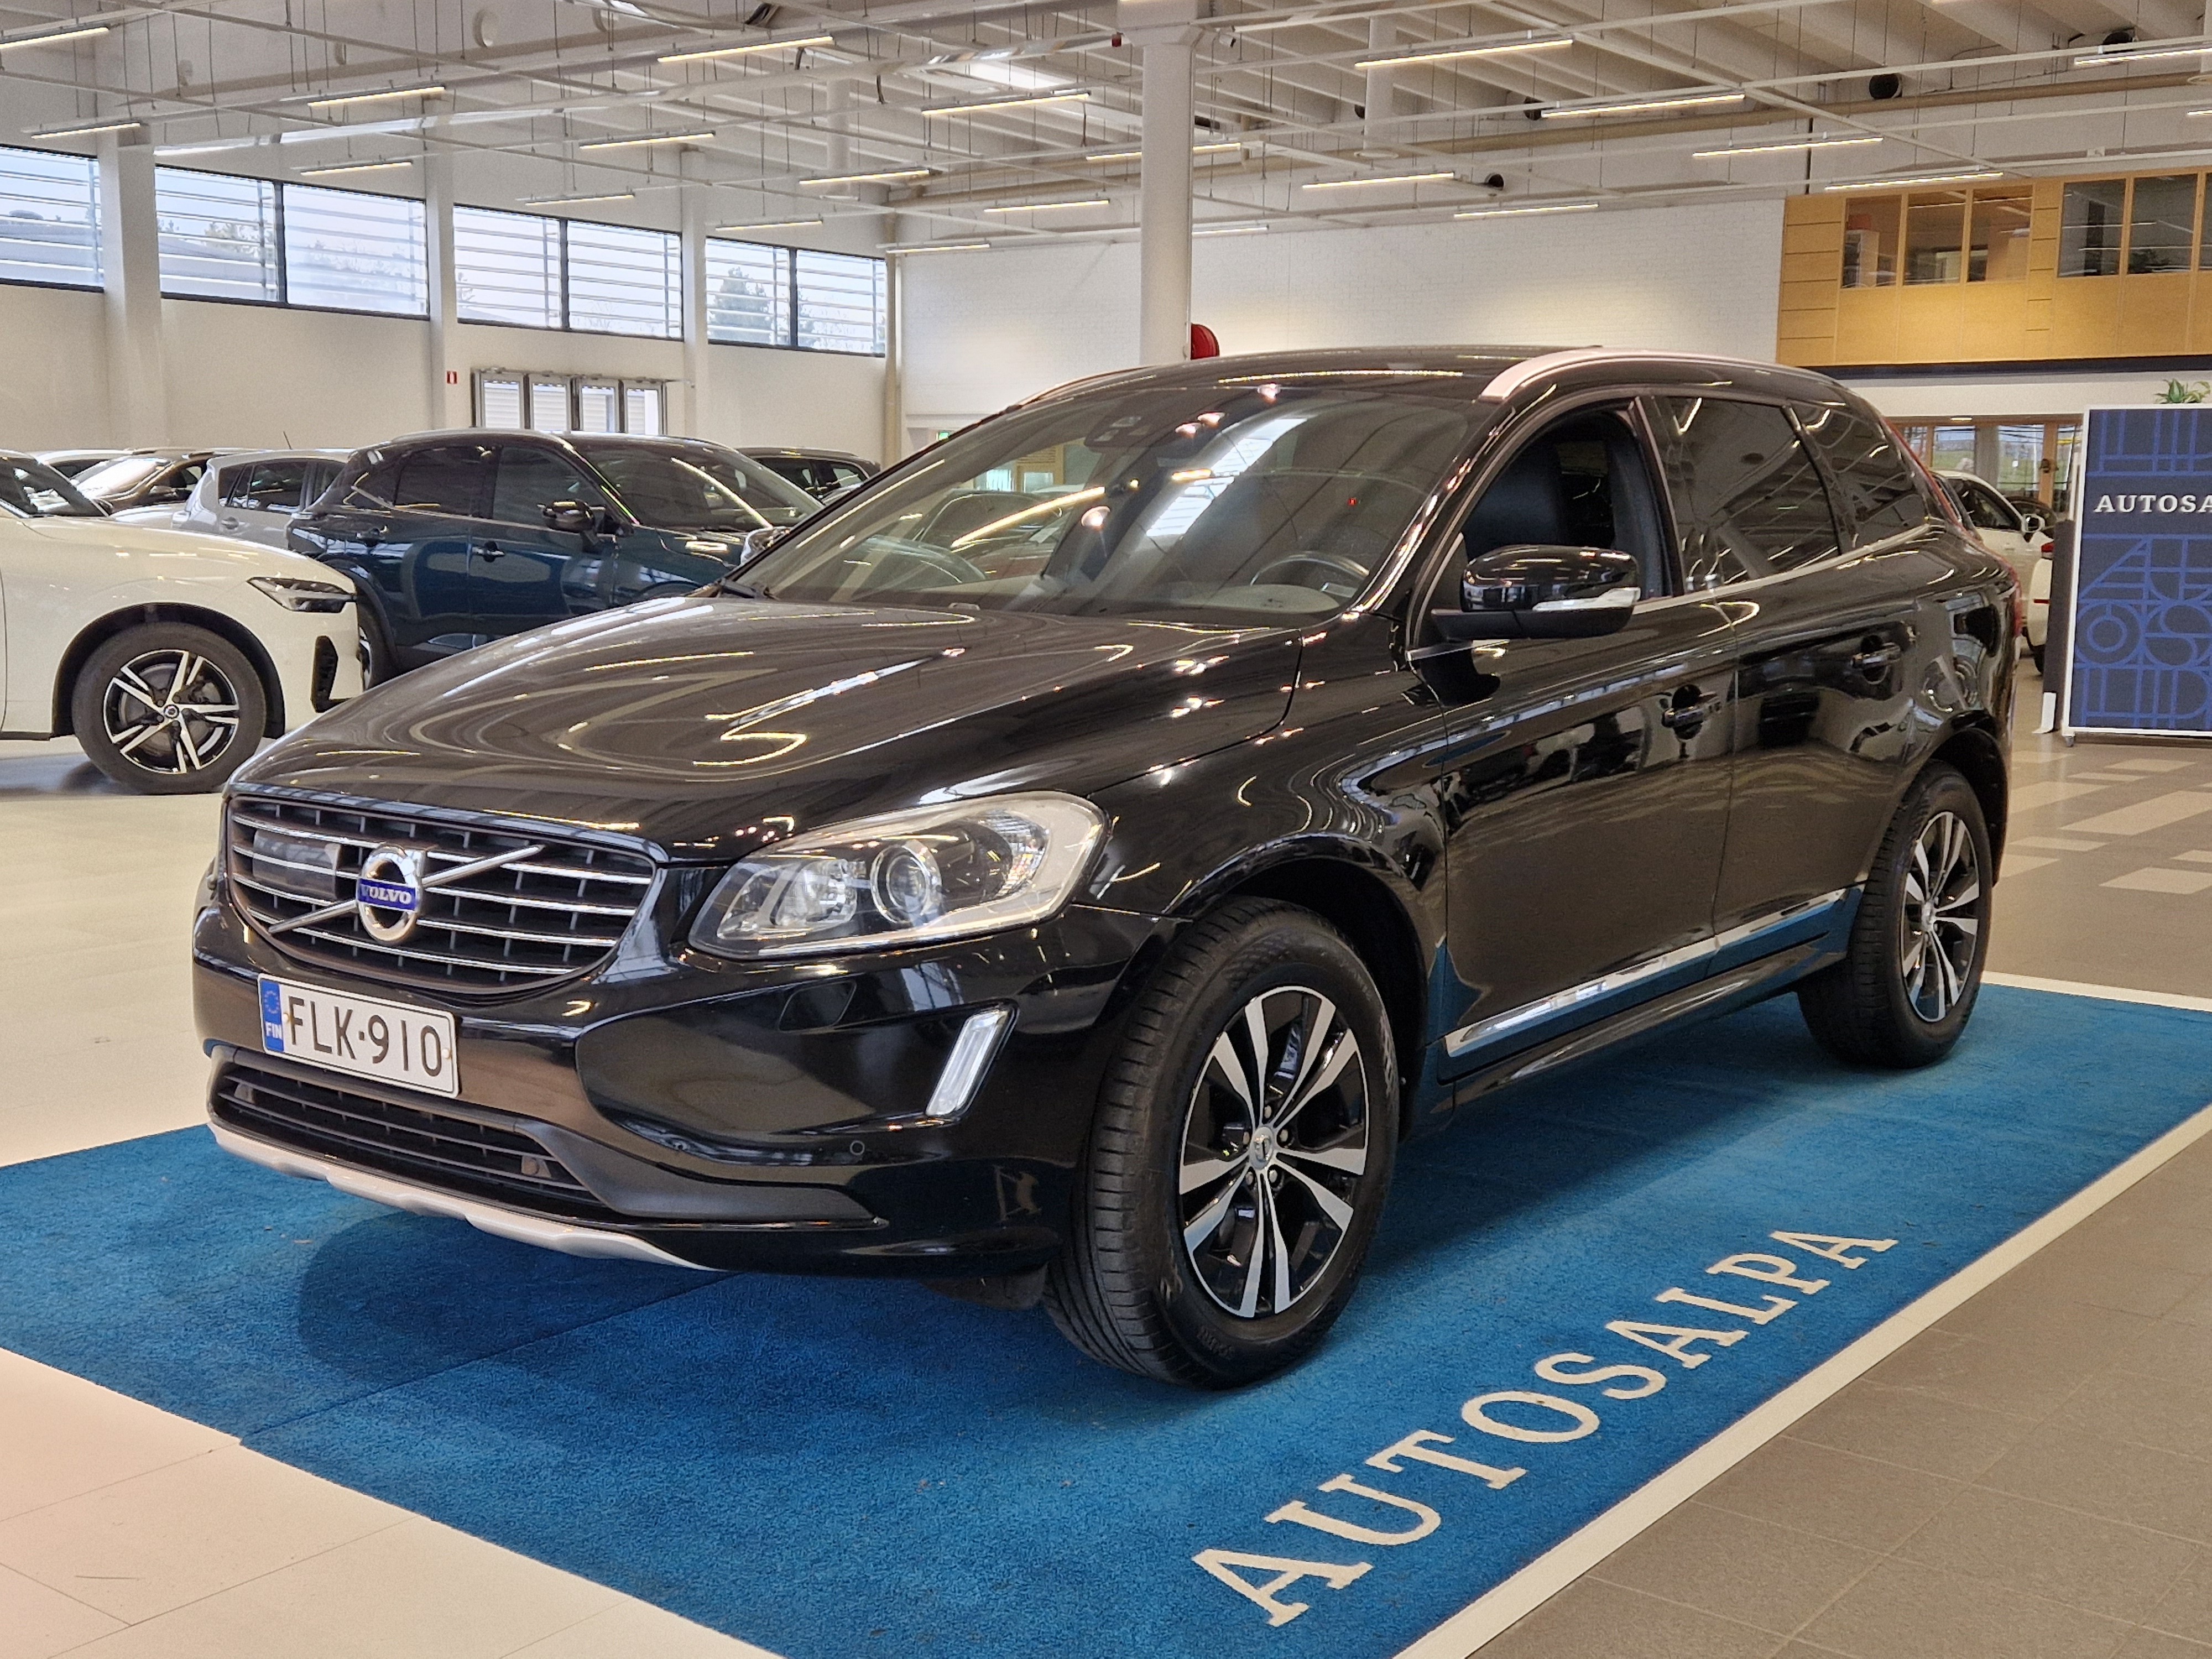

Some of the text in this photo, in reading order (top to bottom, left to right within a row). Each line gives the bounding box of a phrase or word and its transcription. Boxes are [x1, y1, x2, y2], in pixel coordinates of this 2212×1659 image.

[2093, 494, 2212, 513] AUTOSA
[361, 884, 412, 905] VOLVO
[265, 1021, 283, 1040] FIN
[289, 996, 442, 1077] FLK-910
[1191, 1230, 1898, 1627] AUTOSALPA
